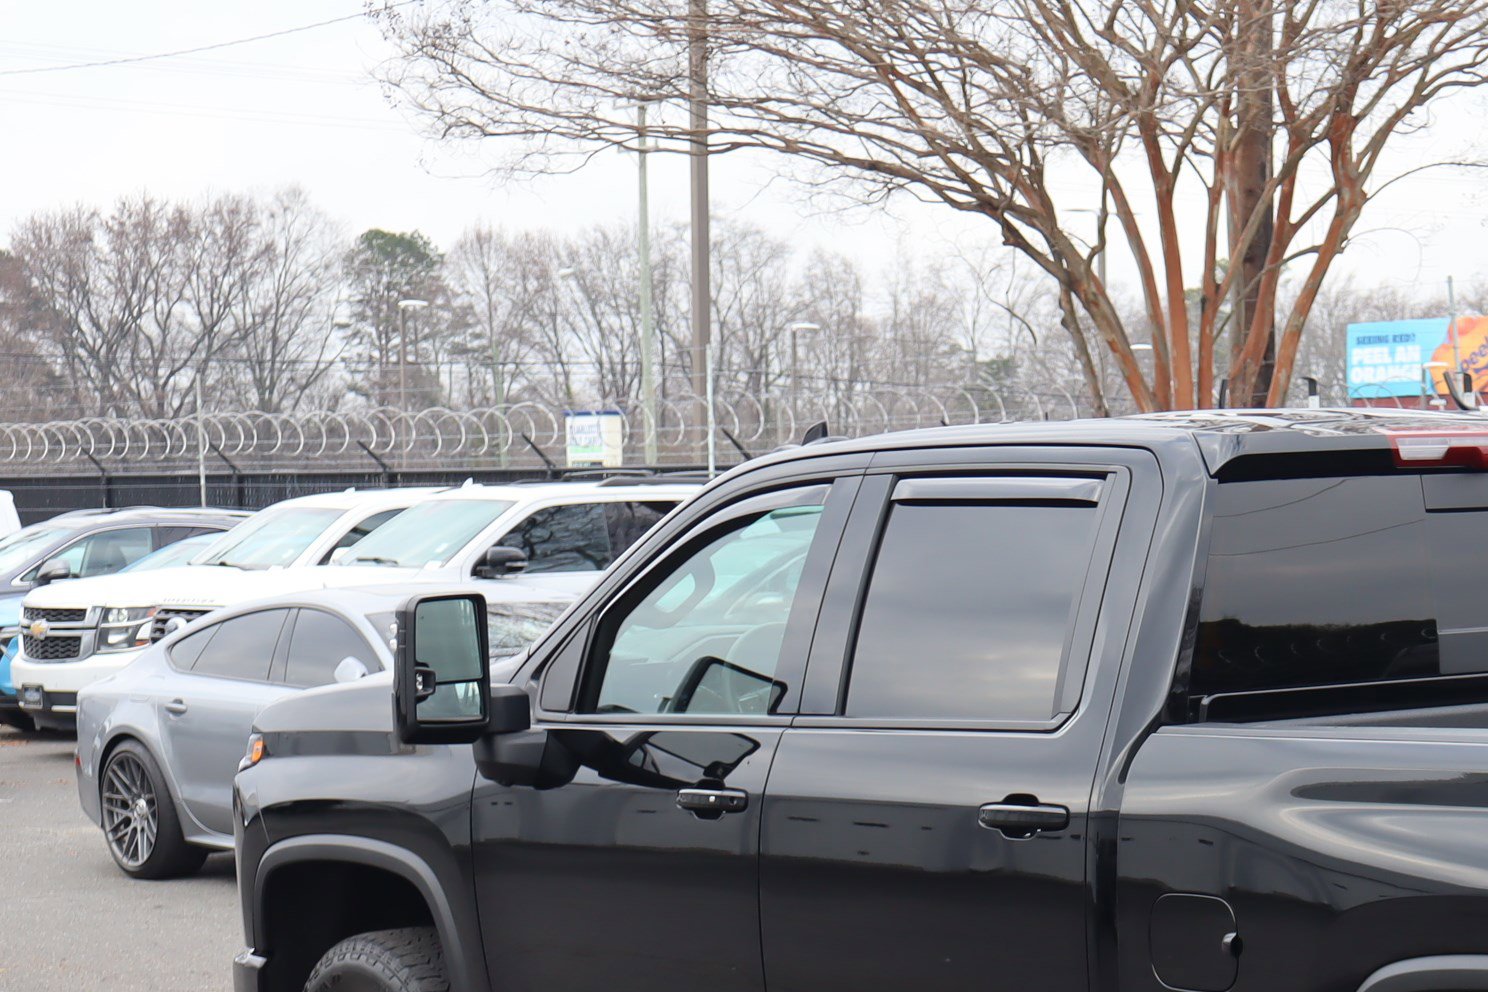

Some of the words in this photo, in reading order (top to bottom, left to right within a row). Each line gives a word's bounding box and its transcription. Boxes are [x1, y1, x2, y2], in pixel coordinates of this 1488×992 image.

[1356, 334, 1389, 345] SEEING
[1351, 347, 1392, 365] PEEL
[1394, 345, 1421, 362] AN
